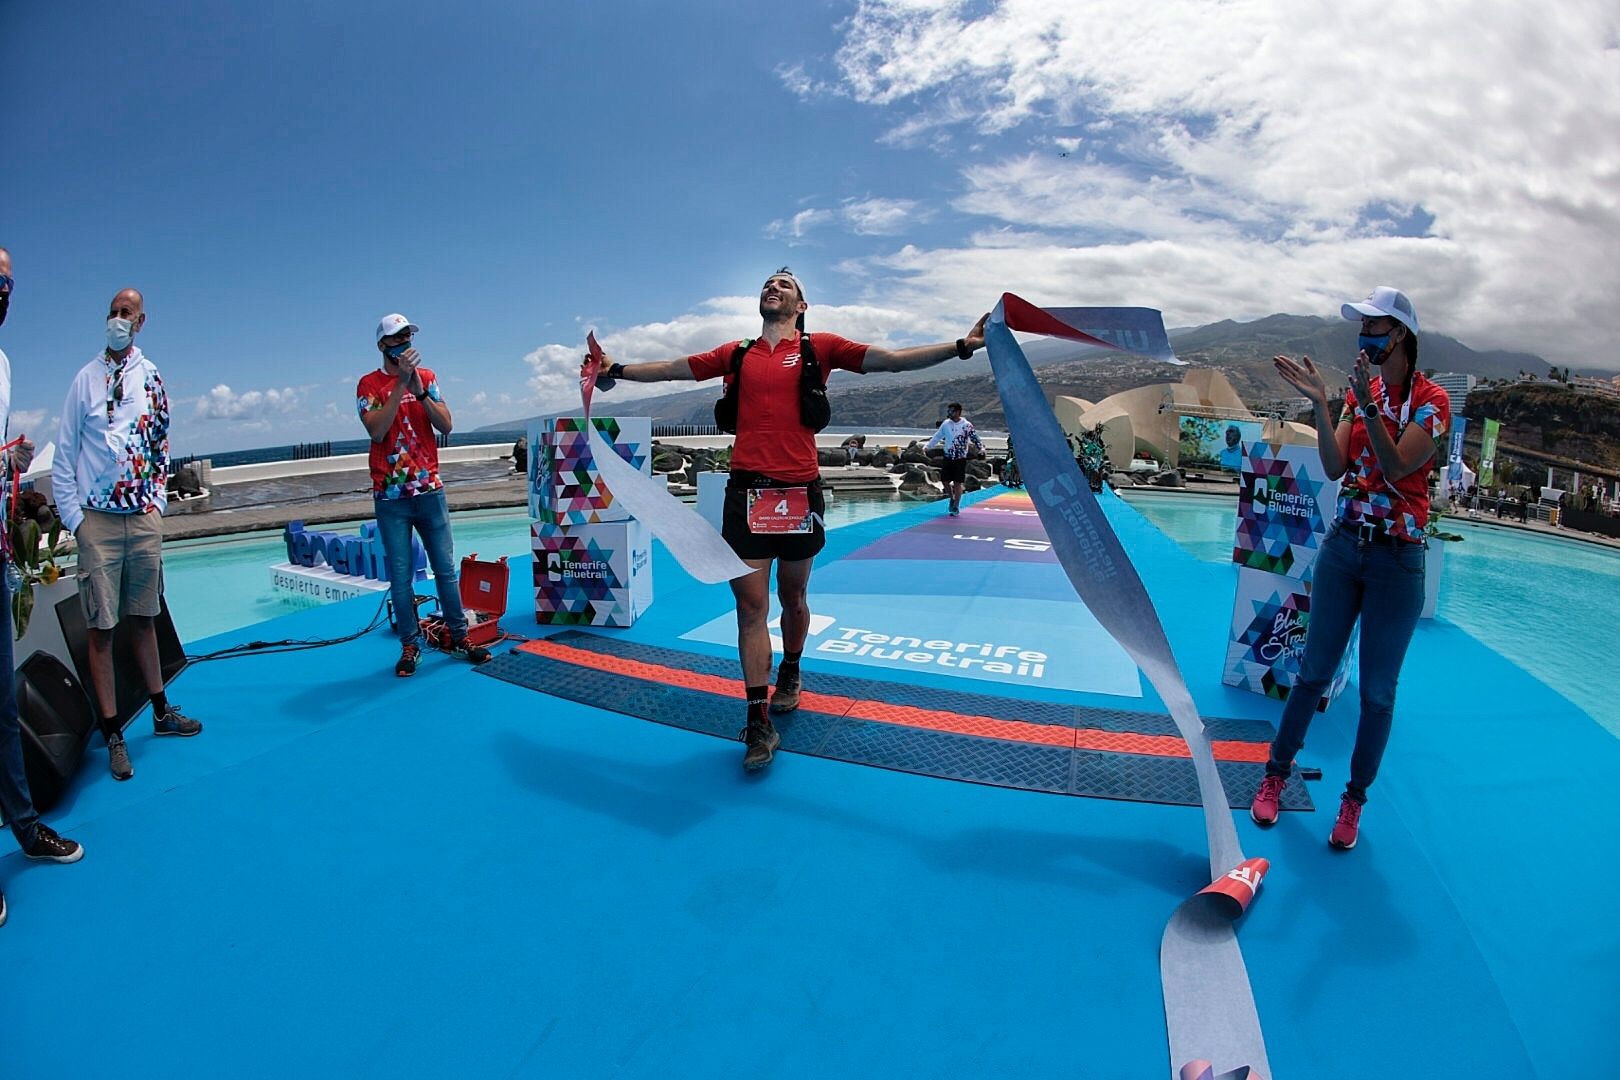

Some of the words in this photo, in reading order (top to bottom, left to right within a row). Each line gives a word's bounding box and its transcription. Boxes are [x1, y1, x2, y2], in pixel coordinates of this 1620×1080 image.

[1268, 489, 1315, 507] Tenerife
[774, 499, 789, 516] 4
[1268, 501, 1314, 518] Bluetrail
[284, 520, 427, 583] tenerif
[1003, 538, 1052, 552] 5
[562, 560, 607, 570] Tenerife
[563, 569, 608, 579] Bluetrail
[274, 571, 320, 596] despierta
[1272, 609, 1304, 634] Blue
[838, 627, 1048, 663] Tenerife
[816, 639, 1046, 678] Bluetrail
